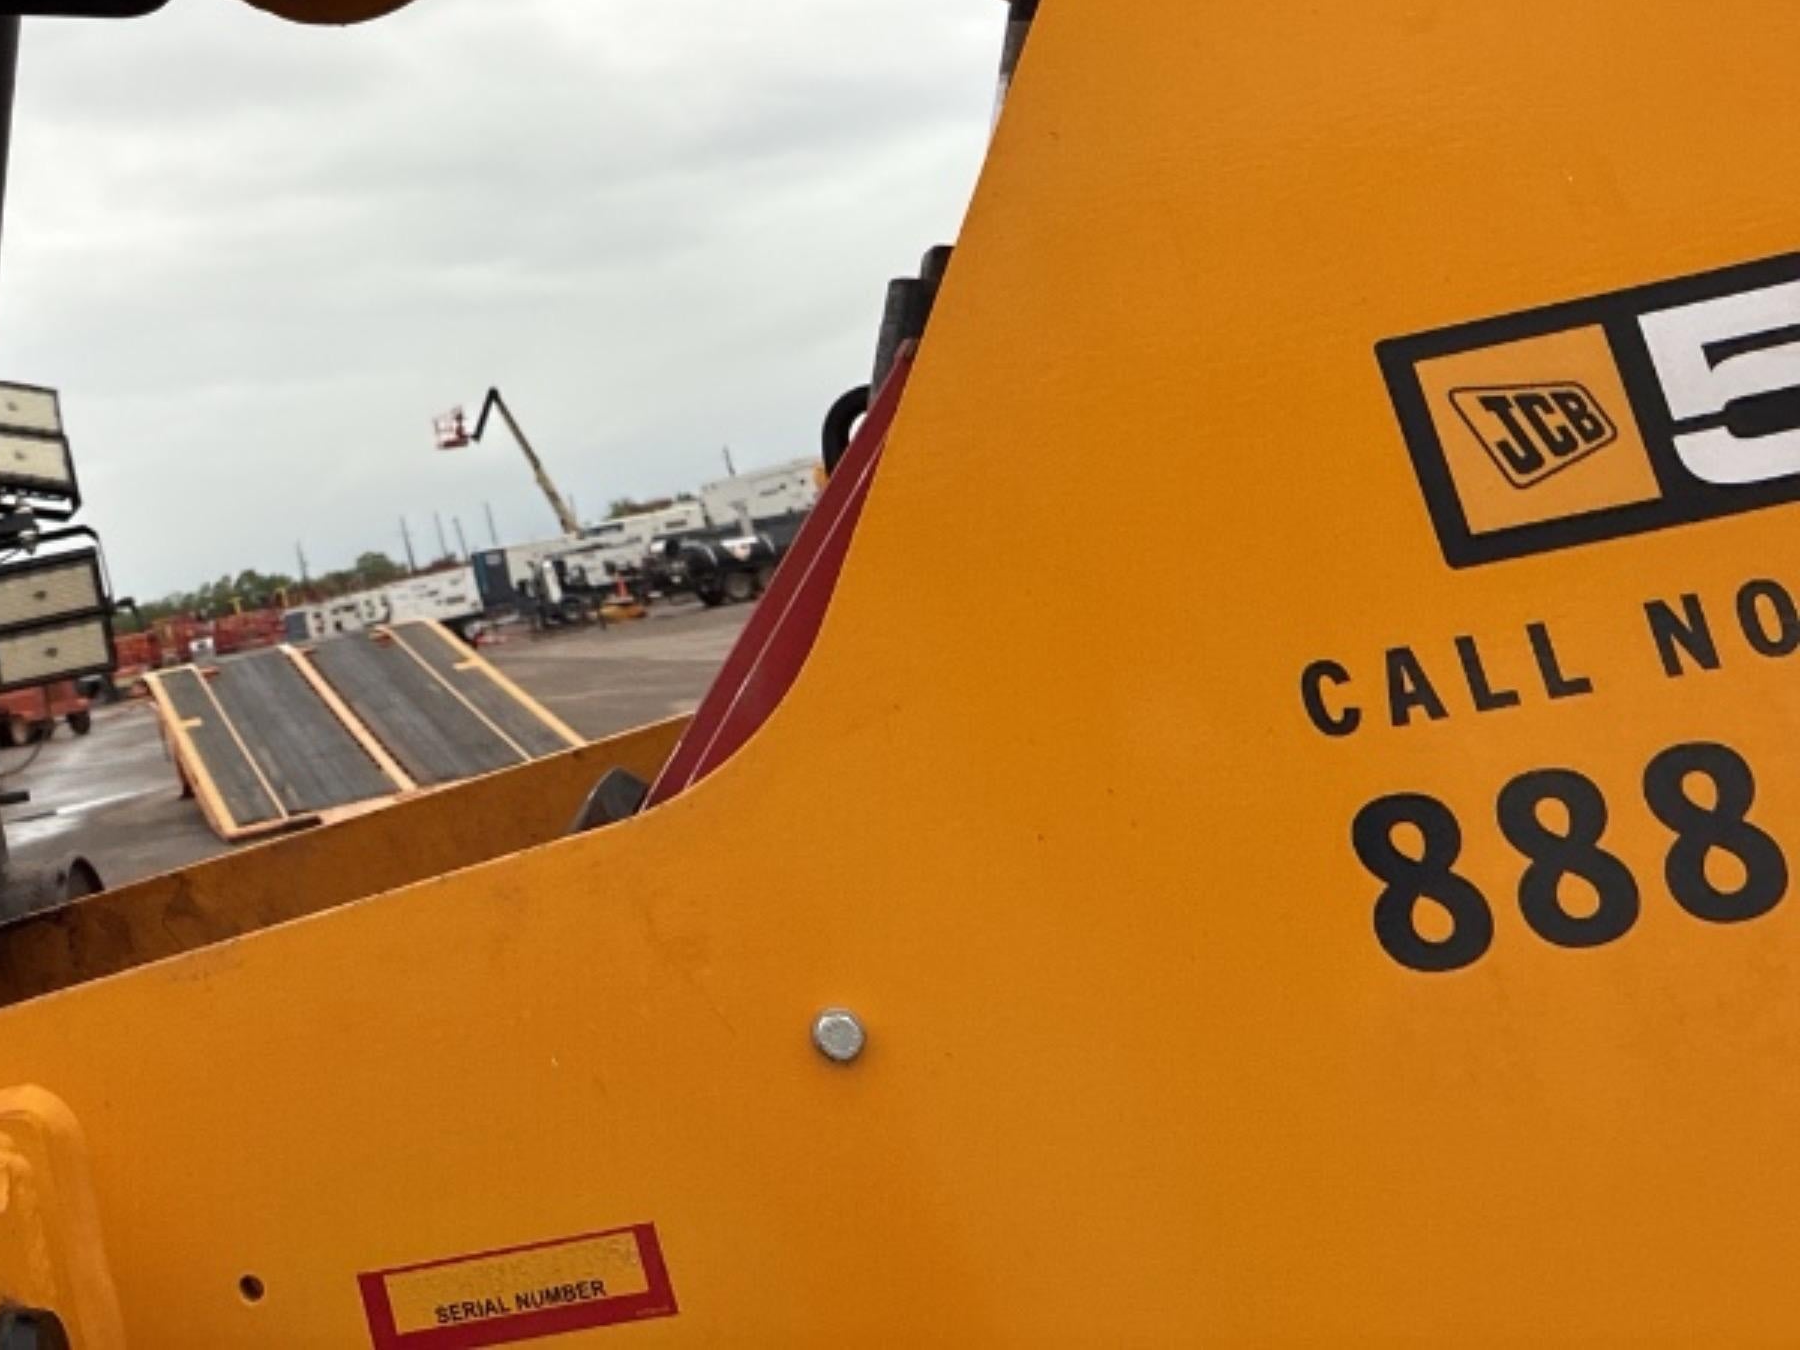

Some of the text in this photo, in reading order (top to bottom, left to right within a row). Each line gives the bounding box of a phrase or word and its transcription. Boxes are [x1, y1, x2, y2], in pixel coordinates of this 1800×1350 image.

[1476, 391, 1607, 475] JCB
[1300, 578, 1800, 737] CALL NO
[1351, 740, 1790, 974] 888
[434, 1297, 511, 1324] SERIAL
[514, 1279, 608, 1310] NUMBER
